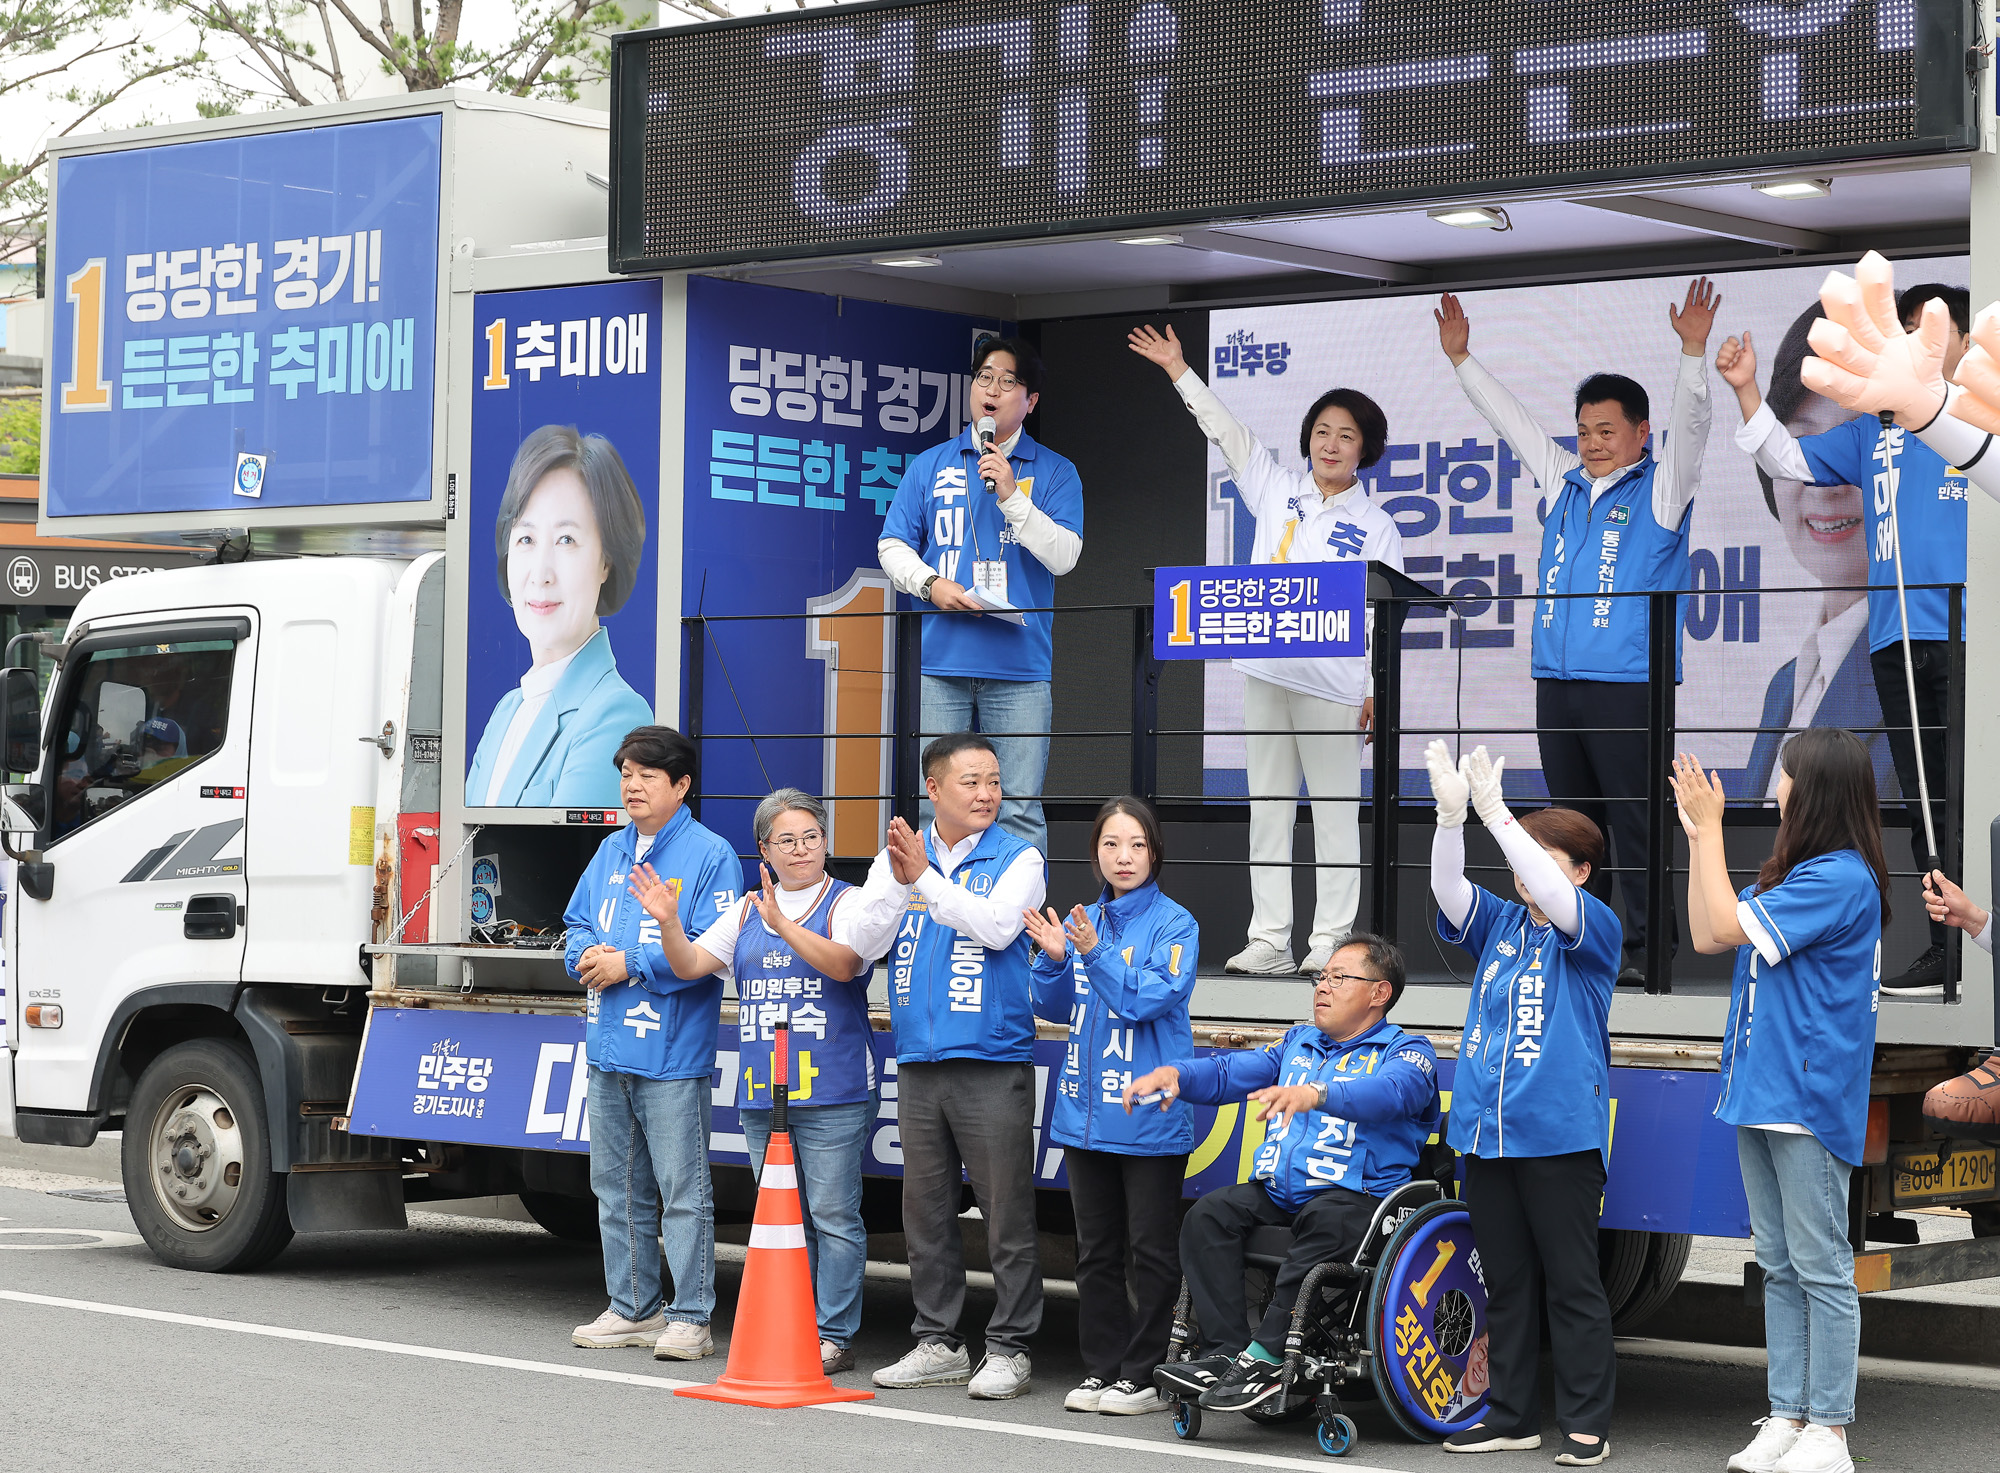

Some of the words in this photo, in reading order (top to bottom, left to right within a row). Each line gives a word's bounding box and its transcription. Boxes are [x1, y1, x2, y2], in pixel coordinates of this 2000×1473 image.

[764, 2, 1178, 227] 경기!
[125, 242, 264, 323] 당당한
[273, 229, 383, 311] 경기!
[60, 256, 113, 414] 1
[483, 317, 511, 391] 1
[514, 312, 649, 382] 추미애
[1214, 342, 1292, 378] 민주당
[121, 331, 261, 411] 든든한
[268, 317, 416, 401] 추미애
[728, 344, 868, 428] 당당한
[709, 429, 851, 512] 든든한
[54, 564, 101, 591] BUS
[1199, 577, 1266, 608] 당당한
[1268, 576, 1319, 607] 경기!
[1167, 579, 1196, 647] 1
[1198, 611, 1273, 645] 든든한
[1275, 609, 1351, 645] 추미애
[175, 864, 221, 877] MIGHTY
[222, 864, 239, 872] GOLD
[762, 954, 793, 969] 민주당
[894, 914, 926, 995] 시의원
[947, 931, 986, 1013] 동원
[1169, 943, 1184, 978] 1
[742, 976, 823, 1001] 시의원후보
[431, 1037, 461, 1057] 더불어
[739, 1001, 828, 1043] 임현숙
[1513, 974, 1546, 1067] 한완수
[416, 1054, 494, 1093] 민주당
[412, 1094, 475, 1118] 경기도지사
[475, 1097, 486, 1119] 후보
[1949, 1154, 1989, 1188] 1290
[1408, 1239, 1457, 1310] 1
[1394, 1303, 1456, 1421] 정진호
